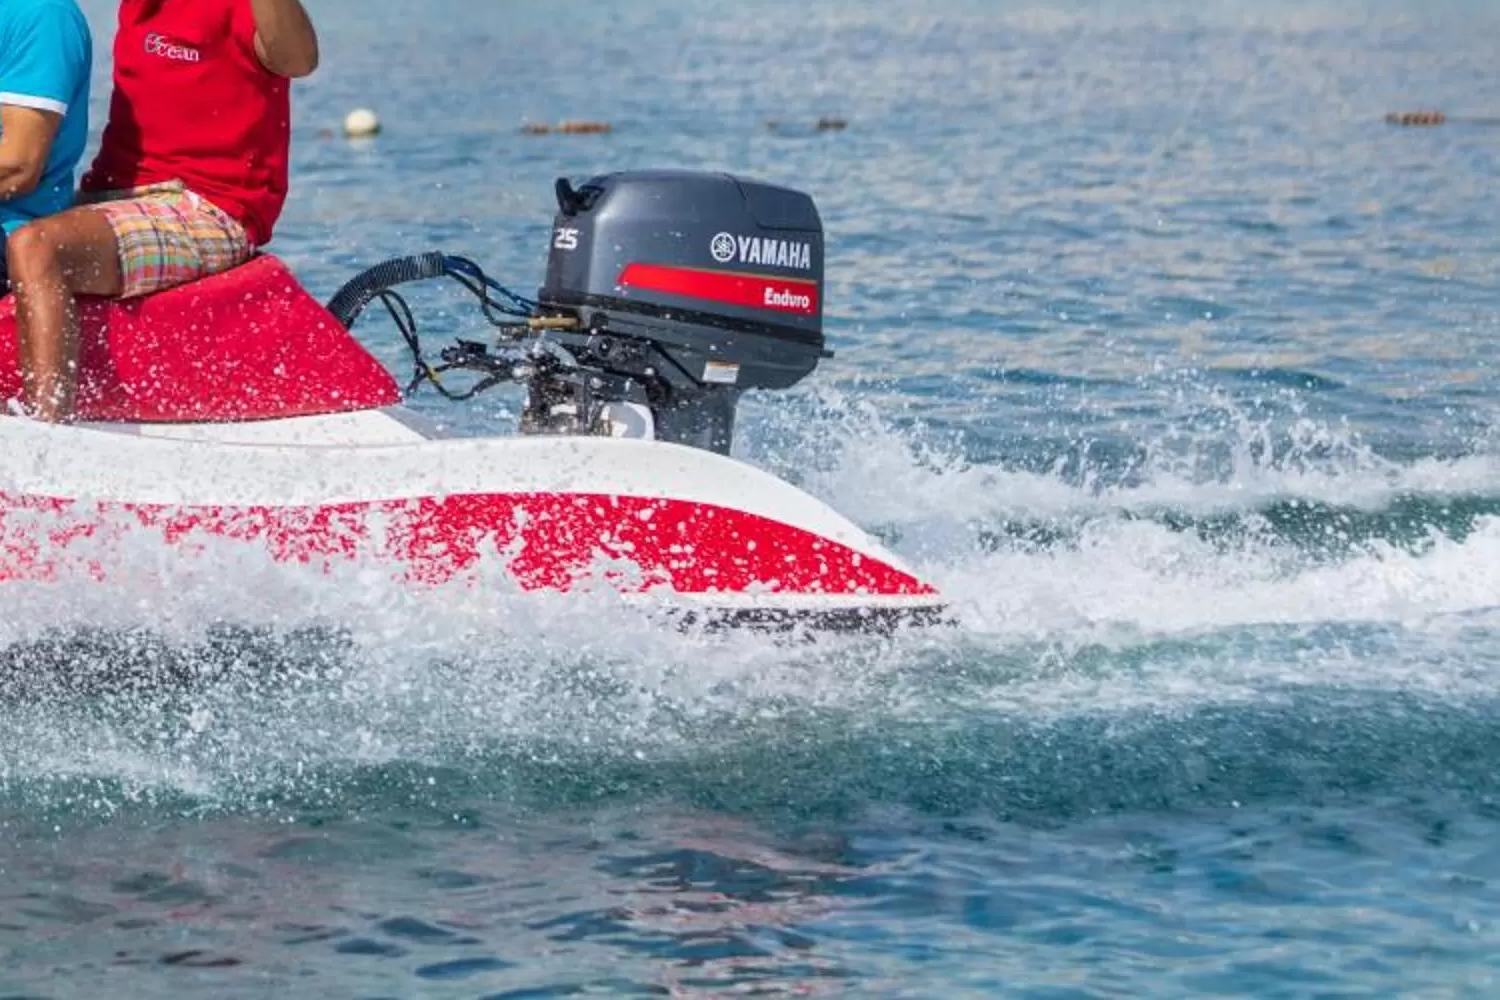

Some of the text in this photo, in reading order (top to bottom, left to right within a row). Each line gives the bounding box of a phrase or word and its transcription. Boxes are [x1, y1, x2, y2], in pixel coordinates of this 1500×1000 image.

[554, 228, 579, 250] 25
[738, 235, 811, 269] YAMAHA
[764, 287, 810, 309] Enduro
